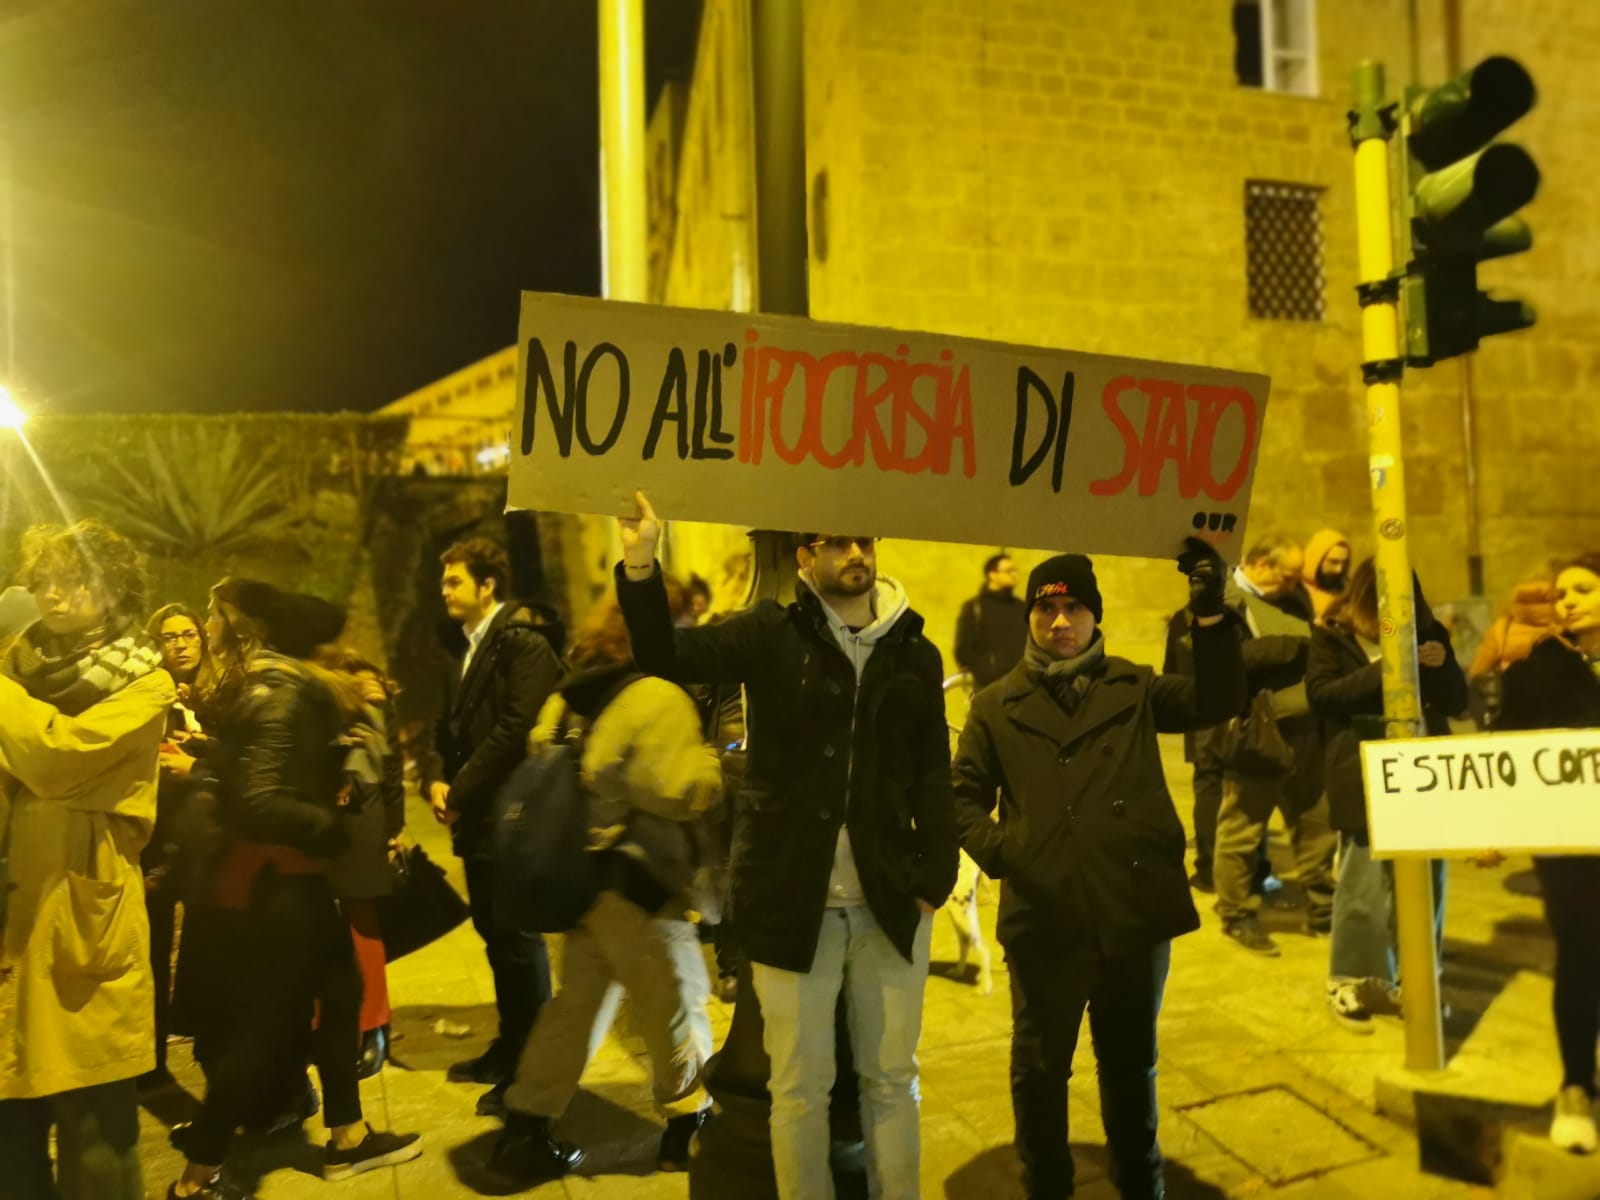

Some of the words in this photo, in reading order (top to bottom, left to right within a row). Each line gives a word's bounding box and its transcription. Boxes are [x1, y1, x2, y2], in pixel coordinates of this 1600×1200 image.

[521, 337, 630, 458] NO
[1009, 366, 1074, 493] DI
[1089, 375, 1257, 502] STATO
[1192, 511, 1238, 533] OUR
[1413, 751, 1517, 793] STATO
